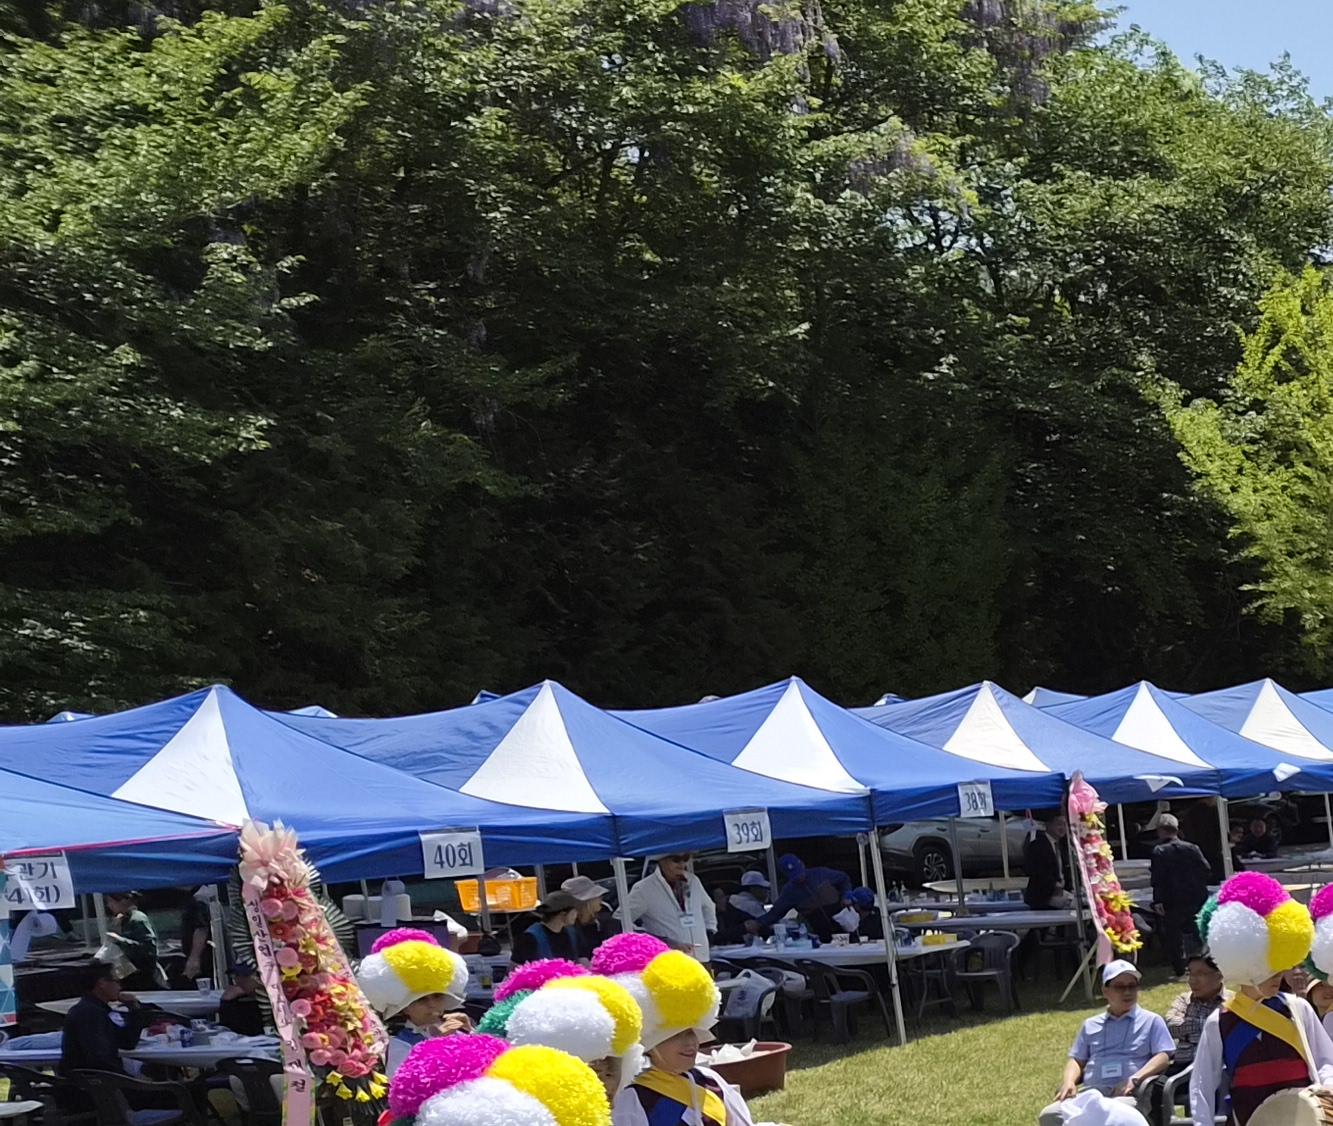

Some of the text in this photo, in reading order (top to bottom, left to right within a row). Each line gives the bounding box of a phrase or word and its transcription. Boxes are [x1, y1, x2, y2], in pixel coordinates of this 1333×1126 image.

[964, 791, 987, 811] 38회
[733, 821, 763, 845] 39회
[434, 842, 473, 869] 40회
